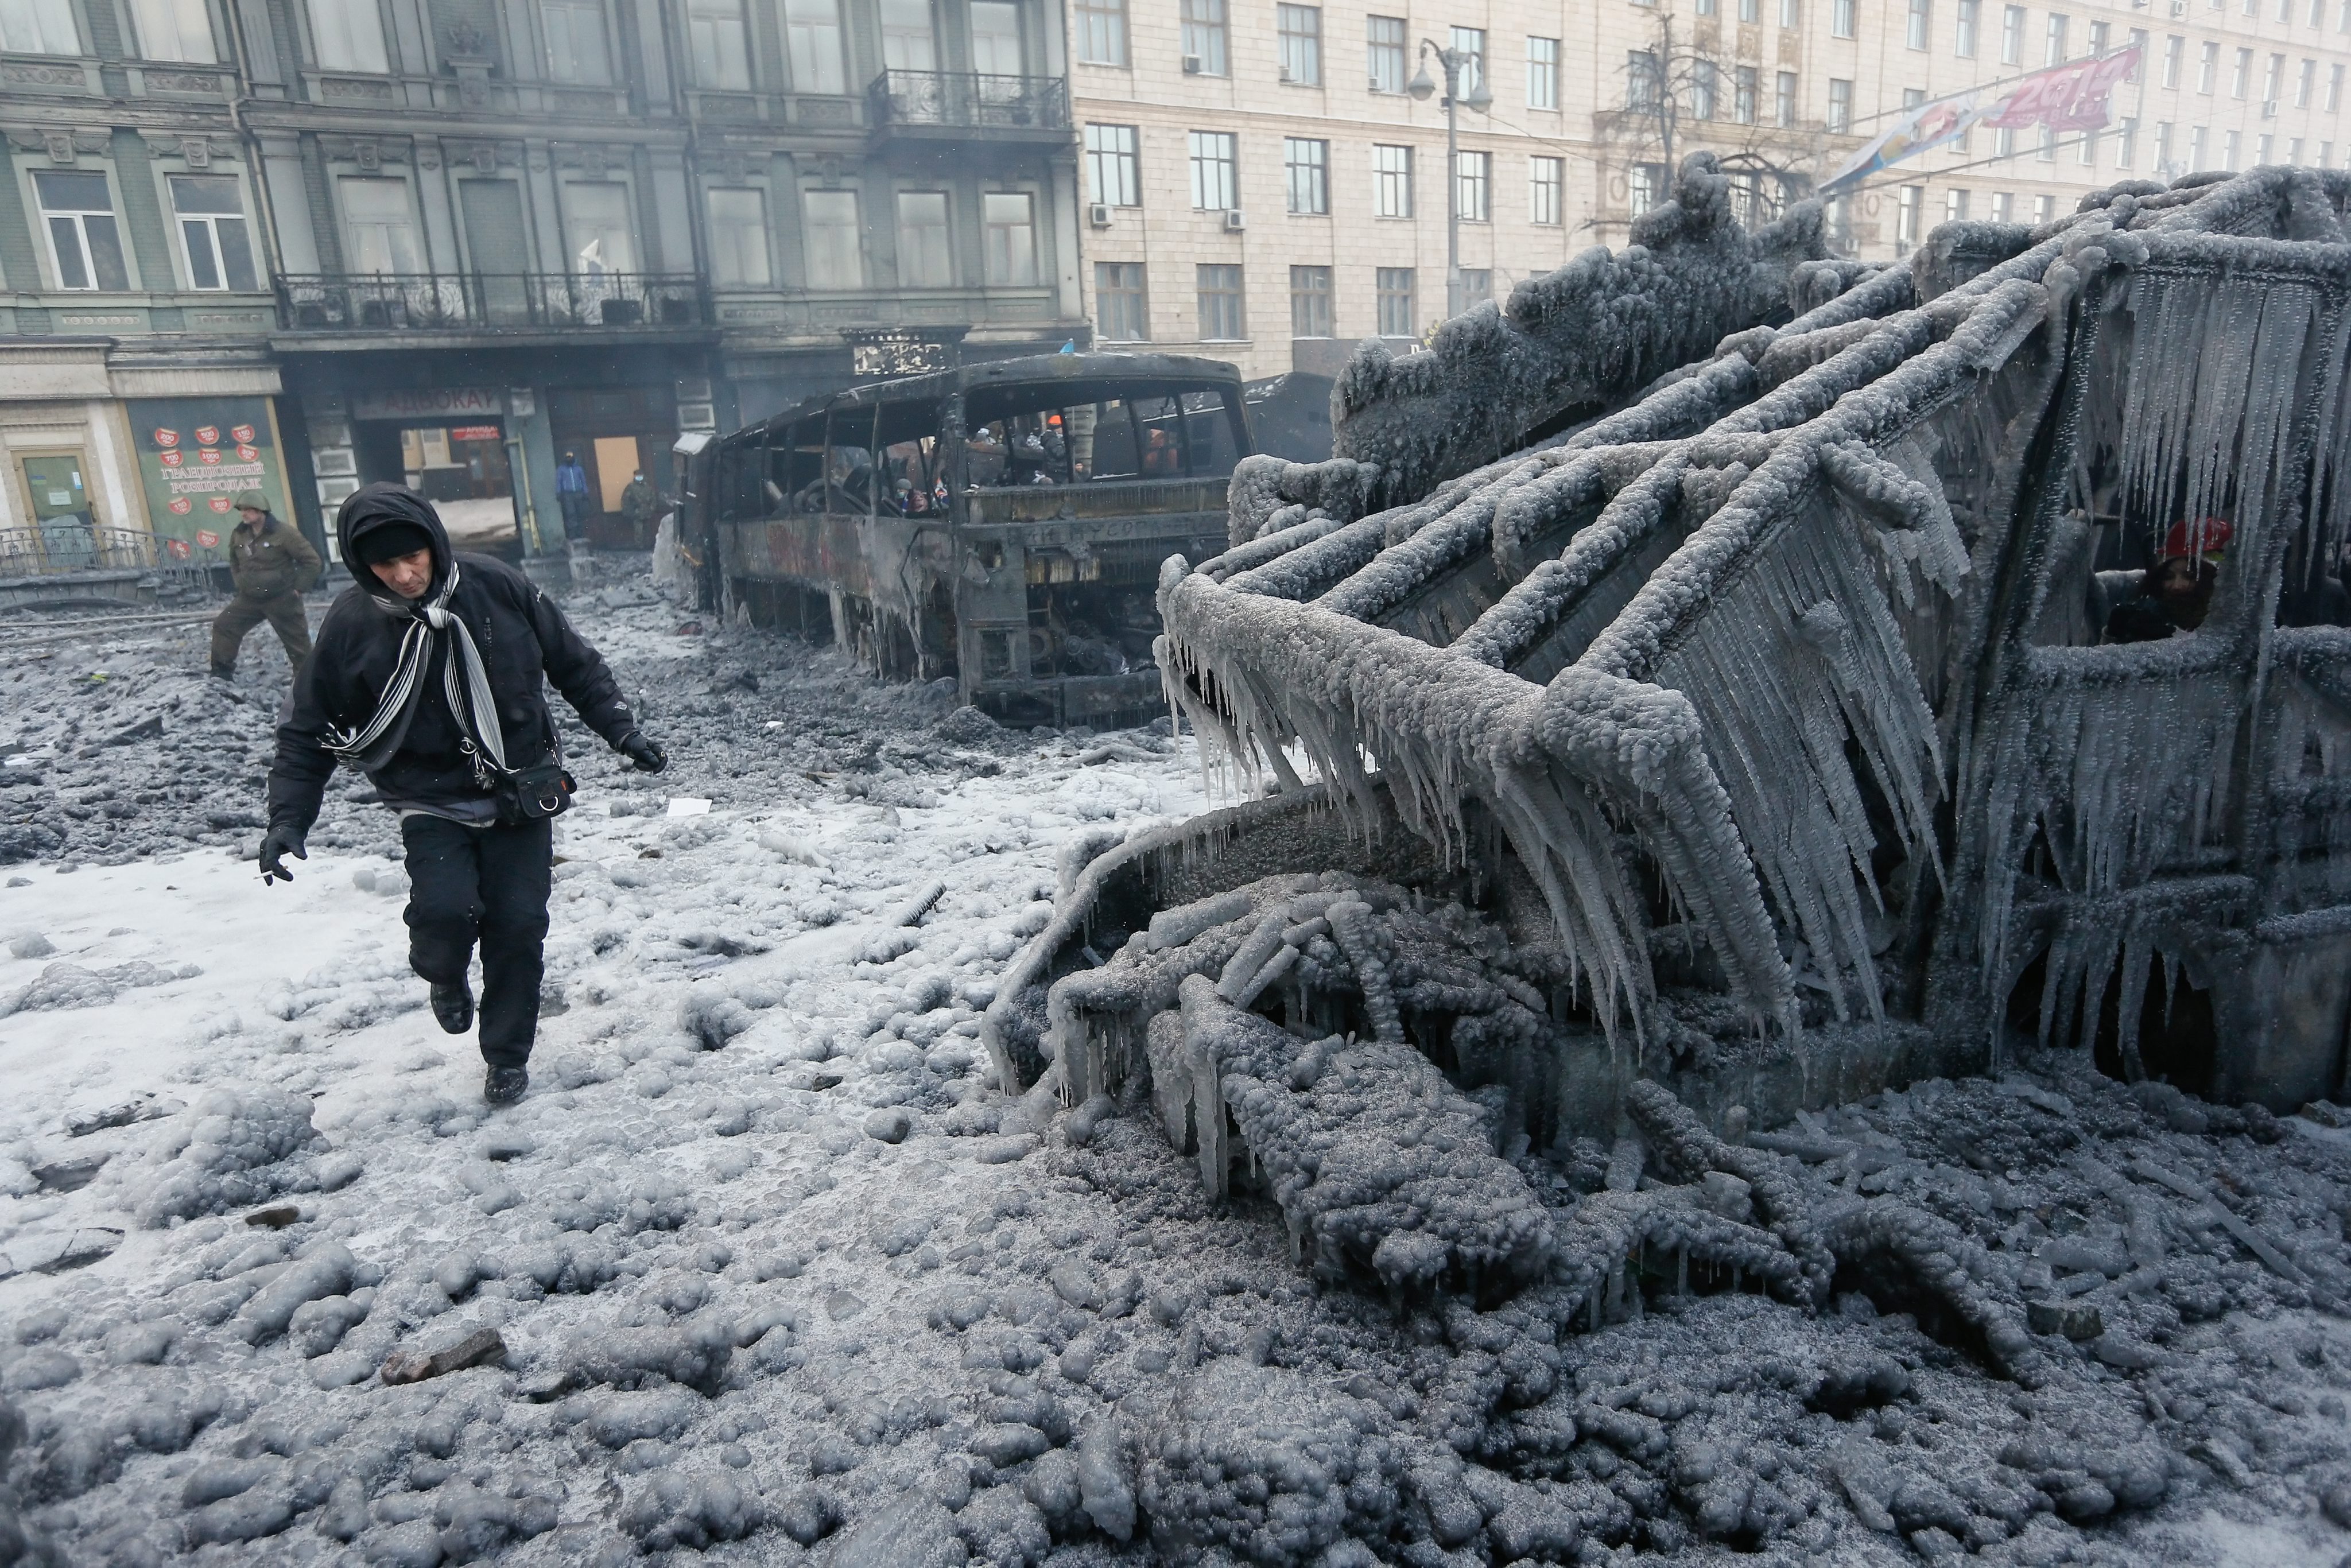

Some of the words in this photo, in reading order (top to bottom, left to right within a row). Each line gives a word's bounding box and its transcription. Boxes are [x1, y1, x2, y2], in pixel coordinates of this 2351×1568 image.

[2009, 55, 2128, 112] 2014
[385, 389, 492, 414] АДВОКАТ
[161, 433, 174, 441] 200
[161, 461, 266, 480] ГРАНДІОЗНИЙ
[170, 478, 263, 494] РОЗПРОДАЖ
